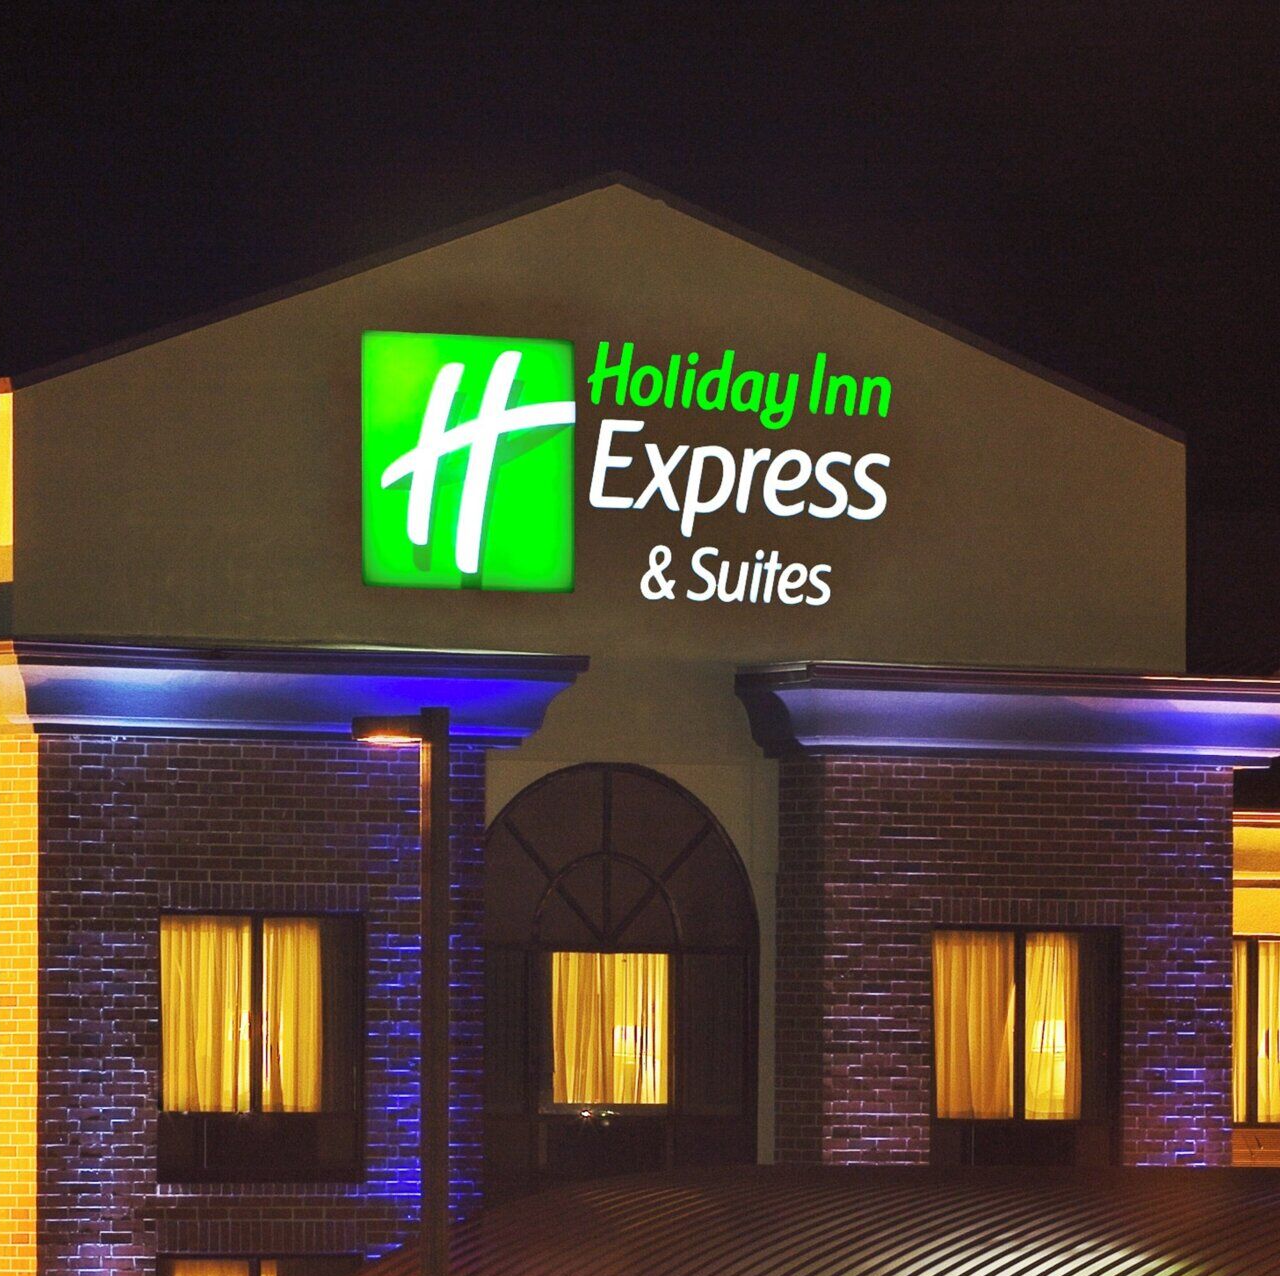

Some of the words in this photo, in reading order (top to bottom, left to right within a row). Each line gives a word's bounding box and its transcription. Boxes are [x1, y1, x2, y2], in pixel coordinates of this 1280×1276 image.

[587, 341, 799, 430] Holiday
[808, 352, 892, 418] Inn
[588, 418, 891, 538] Express
[640, 544, 676, 600] &
[686, 546, 832, 606] Suites
